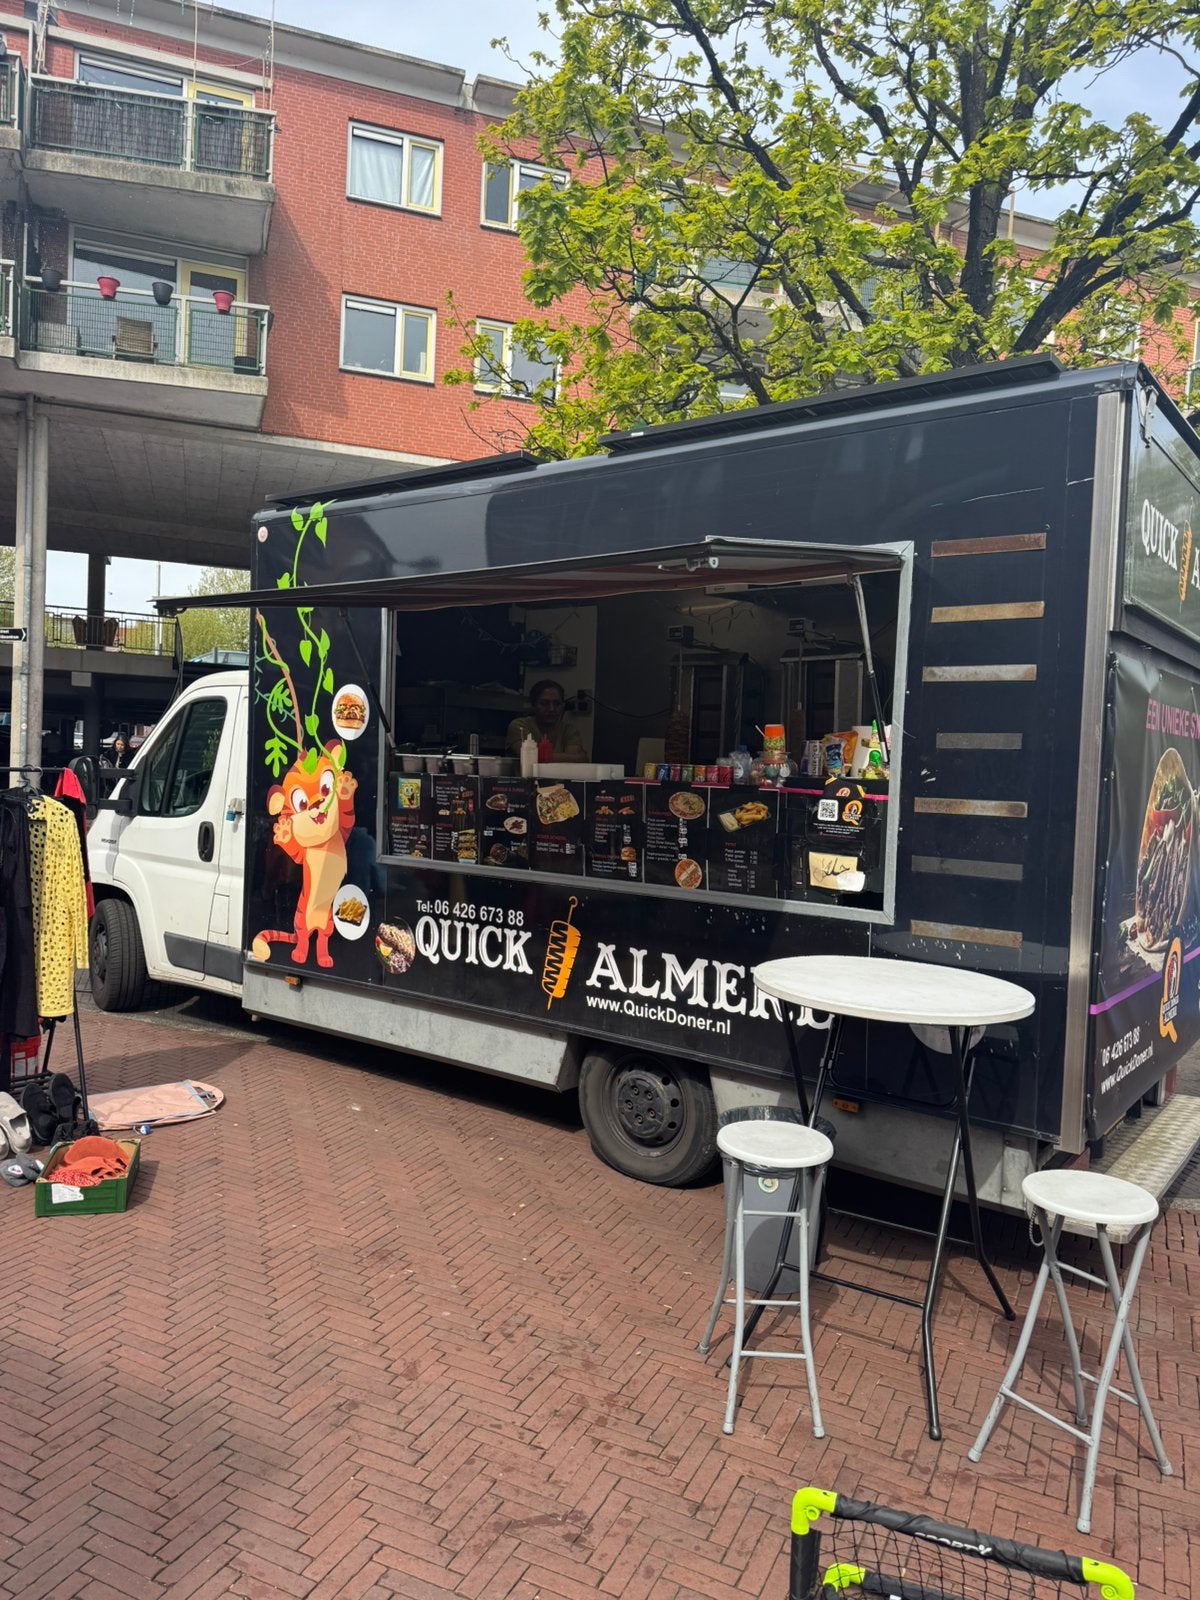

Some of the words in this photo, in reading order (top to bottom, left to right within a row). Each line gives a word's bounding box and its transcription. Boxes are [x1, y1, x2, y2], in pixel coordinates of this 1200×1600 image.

[1141, 498, 1178, 571] QUICK
[1146, 698, 1161, 730] EEN
[1161, 704, 1189, 737] UNIEKE
[416, 899, 433, 914] Tel:
[434, 900, 450, 915] 06
[453, 902, 477, 919] 426
[480, 905, 504, 923] 673
[507, 909, 525, 927] 88
[414, 915, 534, 975] QUICK
[586, 942, 833, 1030] ALMER
[586, 995, 731, 1035] www.QuickDoner.nl
[1101, 1046, 1110, 1067] 06
[1111, 1041, 1123, 1061] 426
[1123, 1030, 1132, 1052] 673
[1132, 1026, 1140, 1045] 88
[1101, 1040, 1154, 1095] www.QuickDoner.nl
